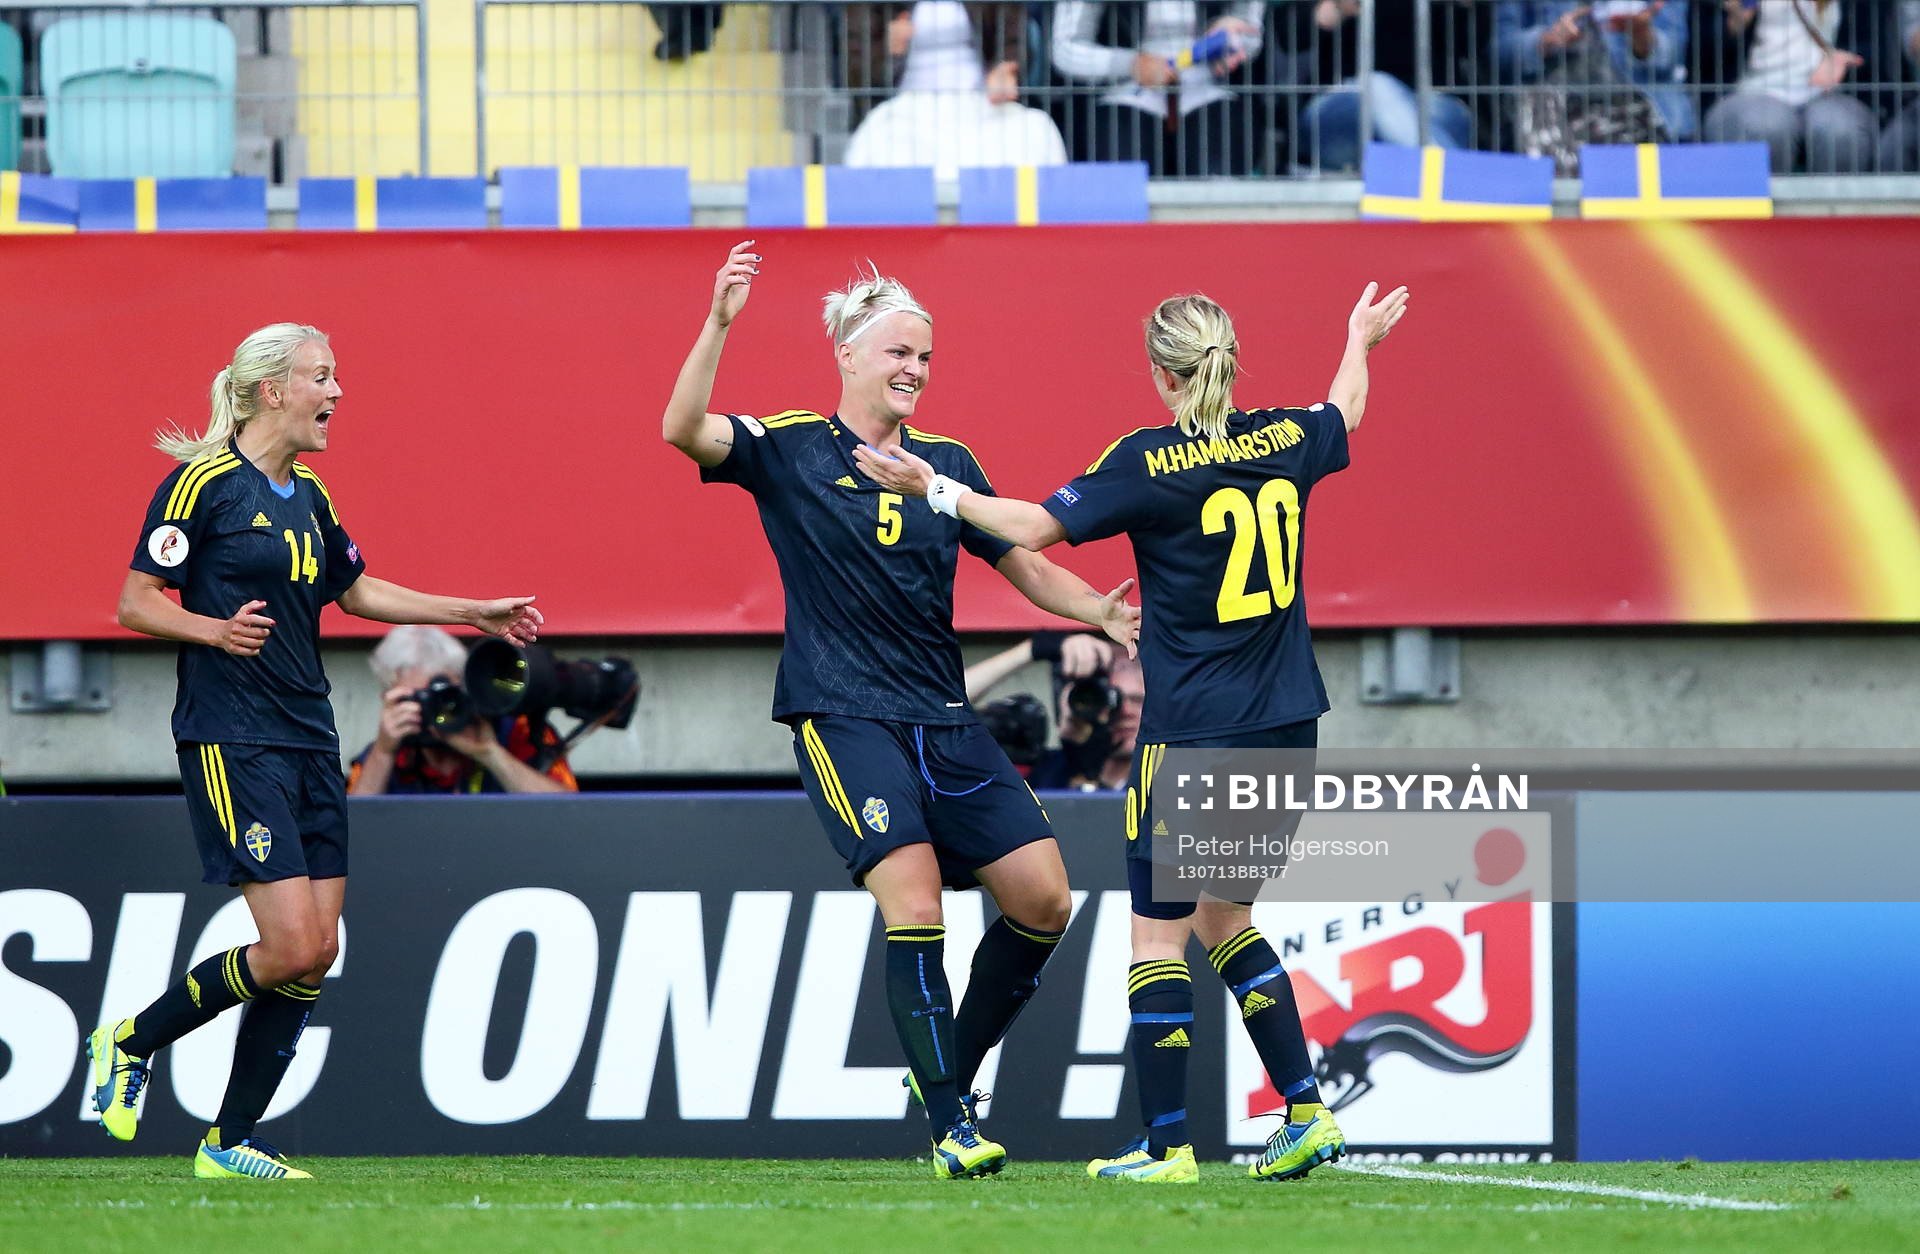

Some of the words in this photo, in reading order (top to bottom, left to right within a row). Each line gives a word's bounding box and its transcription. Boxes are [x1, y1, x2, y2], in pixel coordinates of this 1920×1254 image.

[876, 492, 903, 546] 5
[283, 529, 319, 585] 14
[1201, 478, 1301, 624] 20
[1244, 998, 1277, 1019] adidas
[1154, 1040, 1191, 1048] adidas
